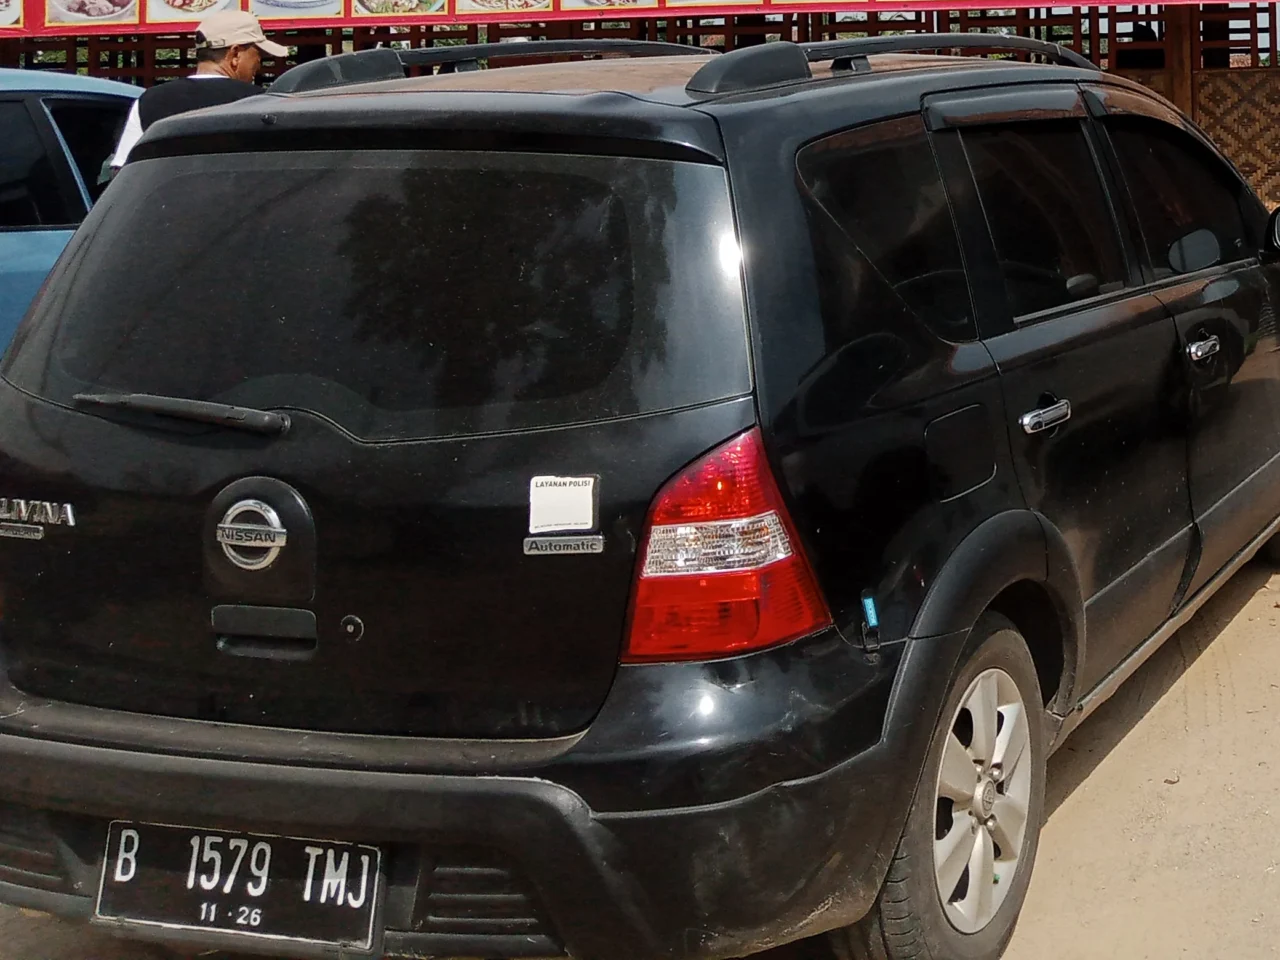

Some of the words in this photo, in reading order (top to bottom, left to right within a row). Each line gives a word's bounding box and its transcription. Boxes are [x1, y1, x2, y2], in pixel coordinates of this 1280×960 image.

[535, 480, 567, 488] LAYANAN
[221, 528, 276, 543] NISSAN
[528, 540, 597, 552] Automatic
[114, 829, 140, 882] B
[186, 835, 272, 897] 1579
[302, 846, 369, 908] TMJ
